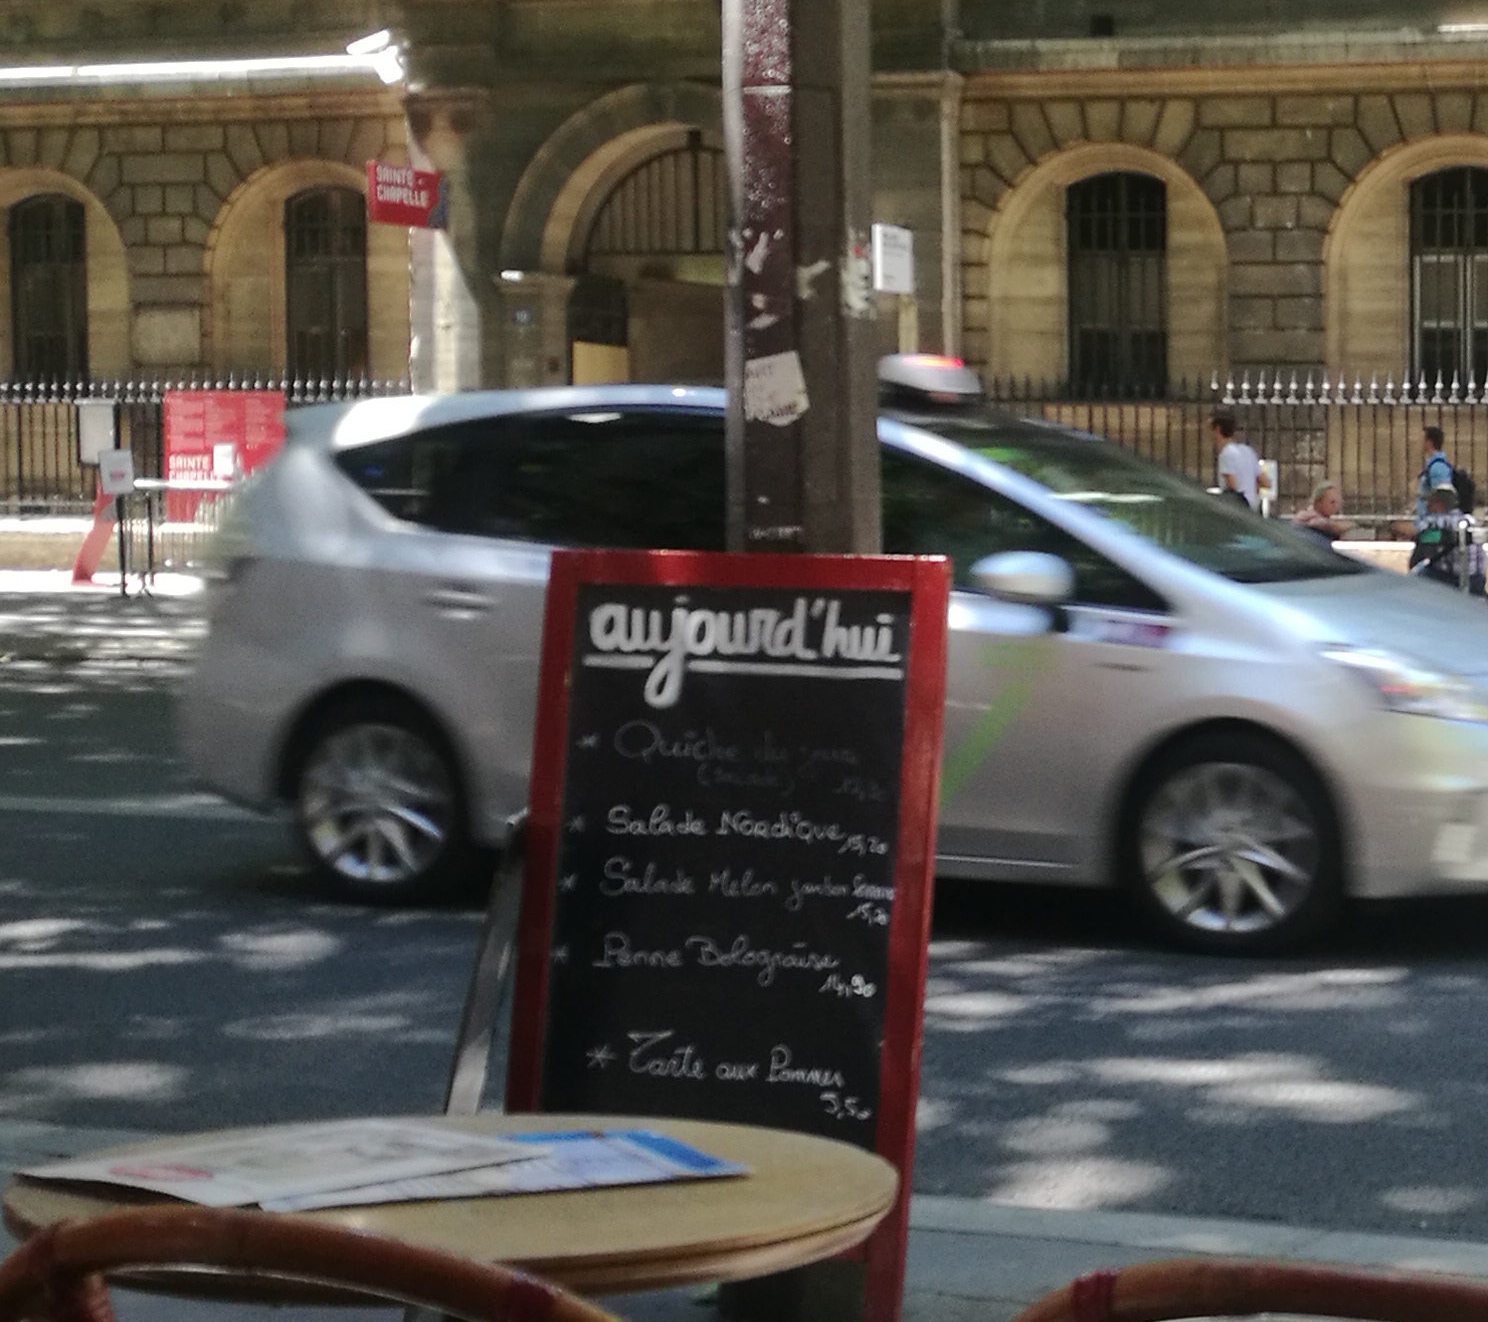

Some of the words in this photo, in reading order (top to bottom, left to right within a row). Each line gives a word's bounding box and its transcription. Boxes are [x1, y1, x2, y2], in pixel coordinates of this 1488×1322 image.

[376, 184, 429, 208] CHAPELLE
[168, 453, 210, 470] SAINTE
[589, 594, 902, 710] aujourd'hui
[604, 803, 707, 837] Salade
[599, 855, 696, 897] Salade
[591, 930, 684, 969] Penne
[627, 1029, 704, 1080] Tarte
[715, 1061, 759, 1081] aux
